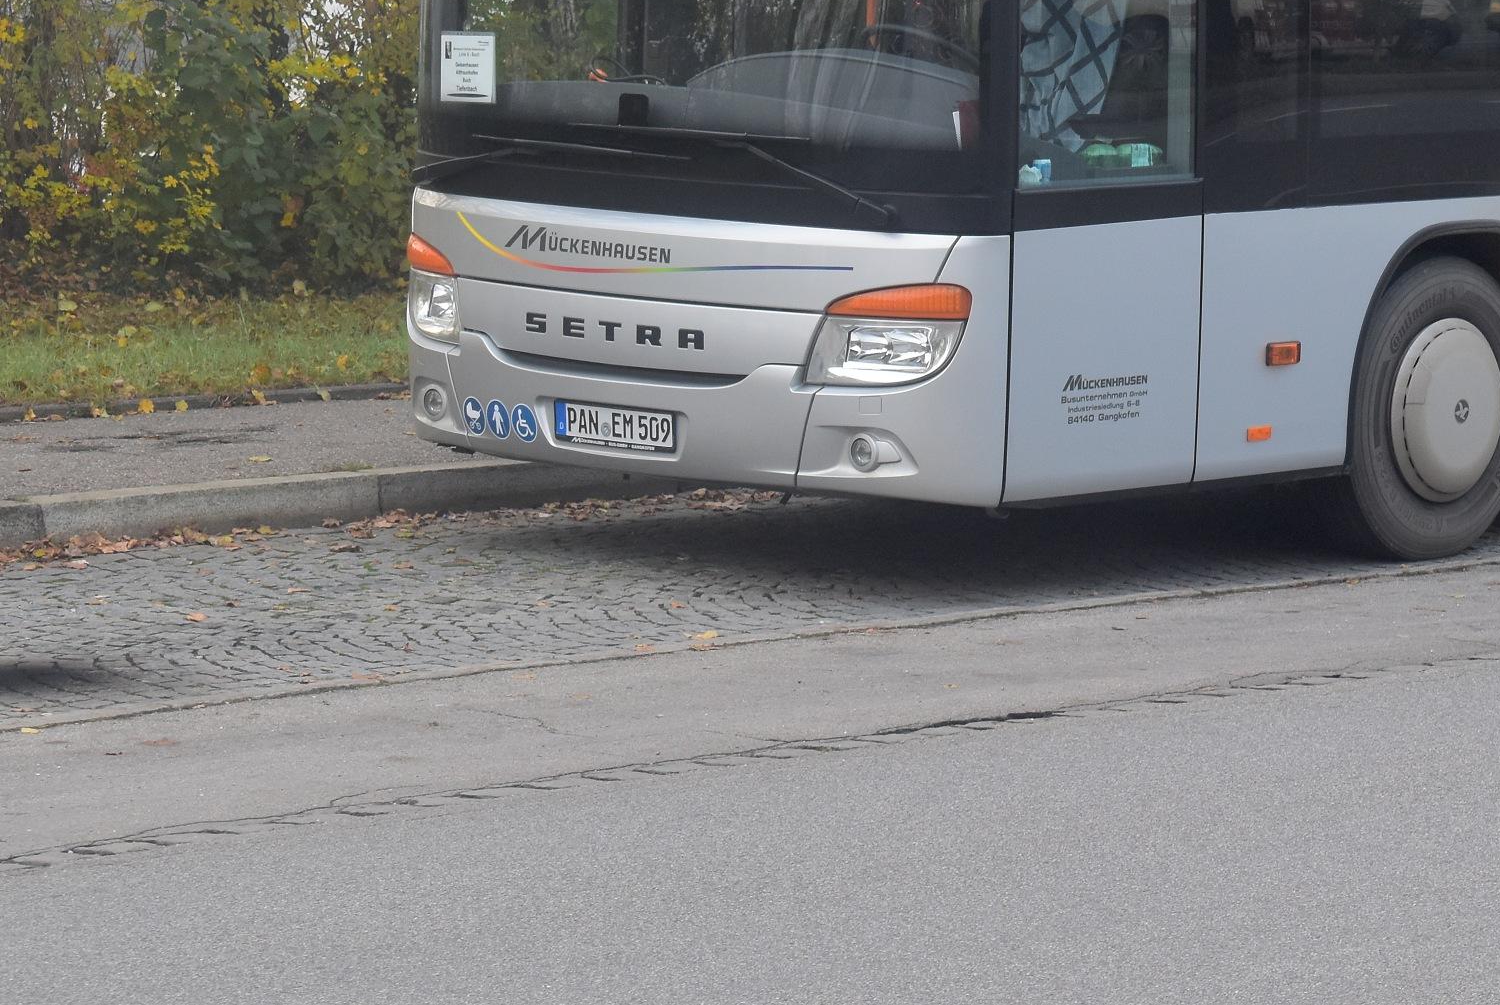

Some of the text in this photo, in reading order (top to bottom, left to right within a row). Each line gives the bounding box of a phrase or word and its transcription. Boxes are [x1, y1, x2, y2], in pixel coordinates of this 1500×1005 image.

[504, 224, 672, 264] MÜCKENHAUSEN
[525, 311, 705, 351] SETRA
[1062, 374, 1148, 392] MÜCKENHAUSEN
[1061, 392, 1128, 404] Busunternehmen
[566, 407, 599, 436] PAN
[611, 412, 634, 439] EM
[638, 415, 671, 443] 509
[1067, 410, 1141, 425] 84140 Gangkofen
